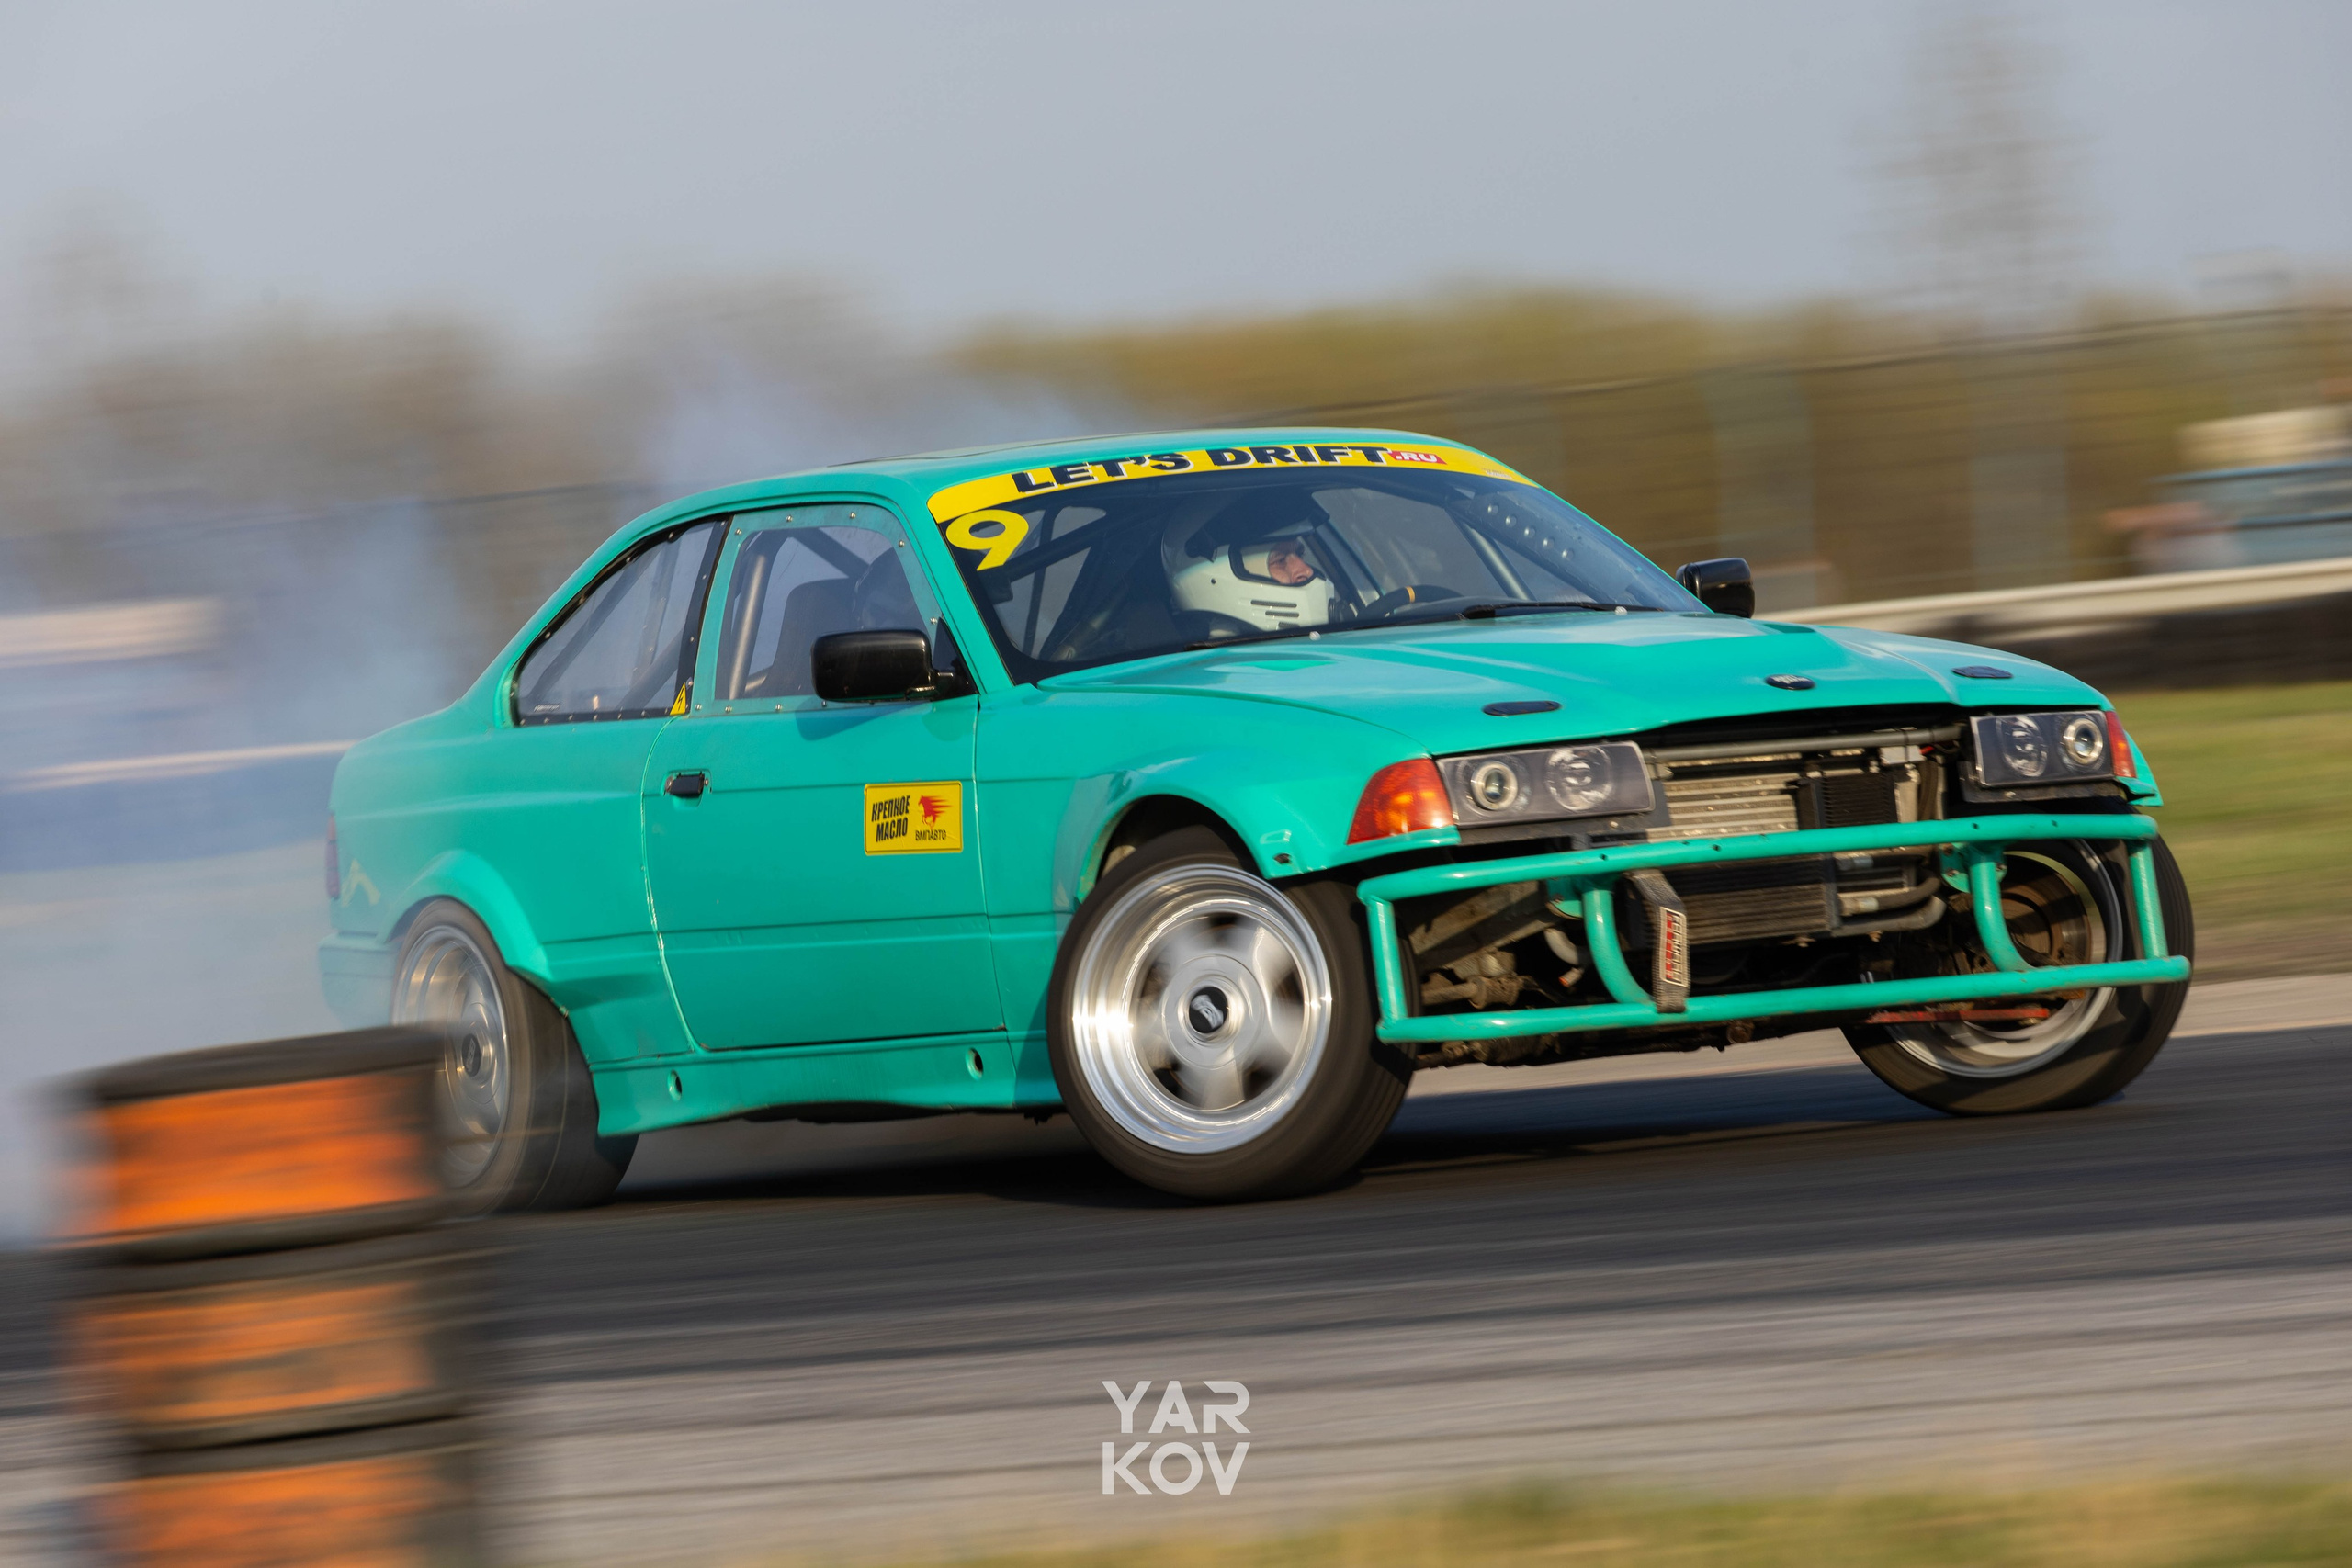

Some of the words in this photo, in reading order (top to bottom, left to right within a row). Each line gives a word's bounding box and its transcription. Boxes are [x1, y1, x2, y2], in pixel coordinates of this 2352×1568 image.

[945, 509, 1030, 571] 9
[871, 795, 910, 822] КРЕПКОЕ
[876, 817, 909, 842] МАСЛО
